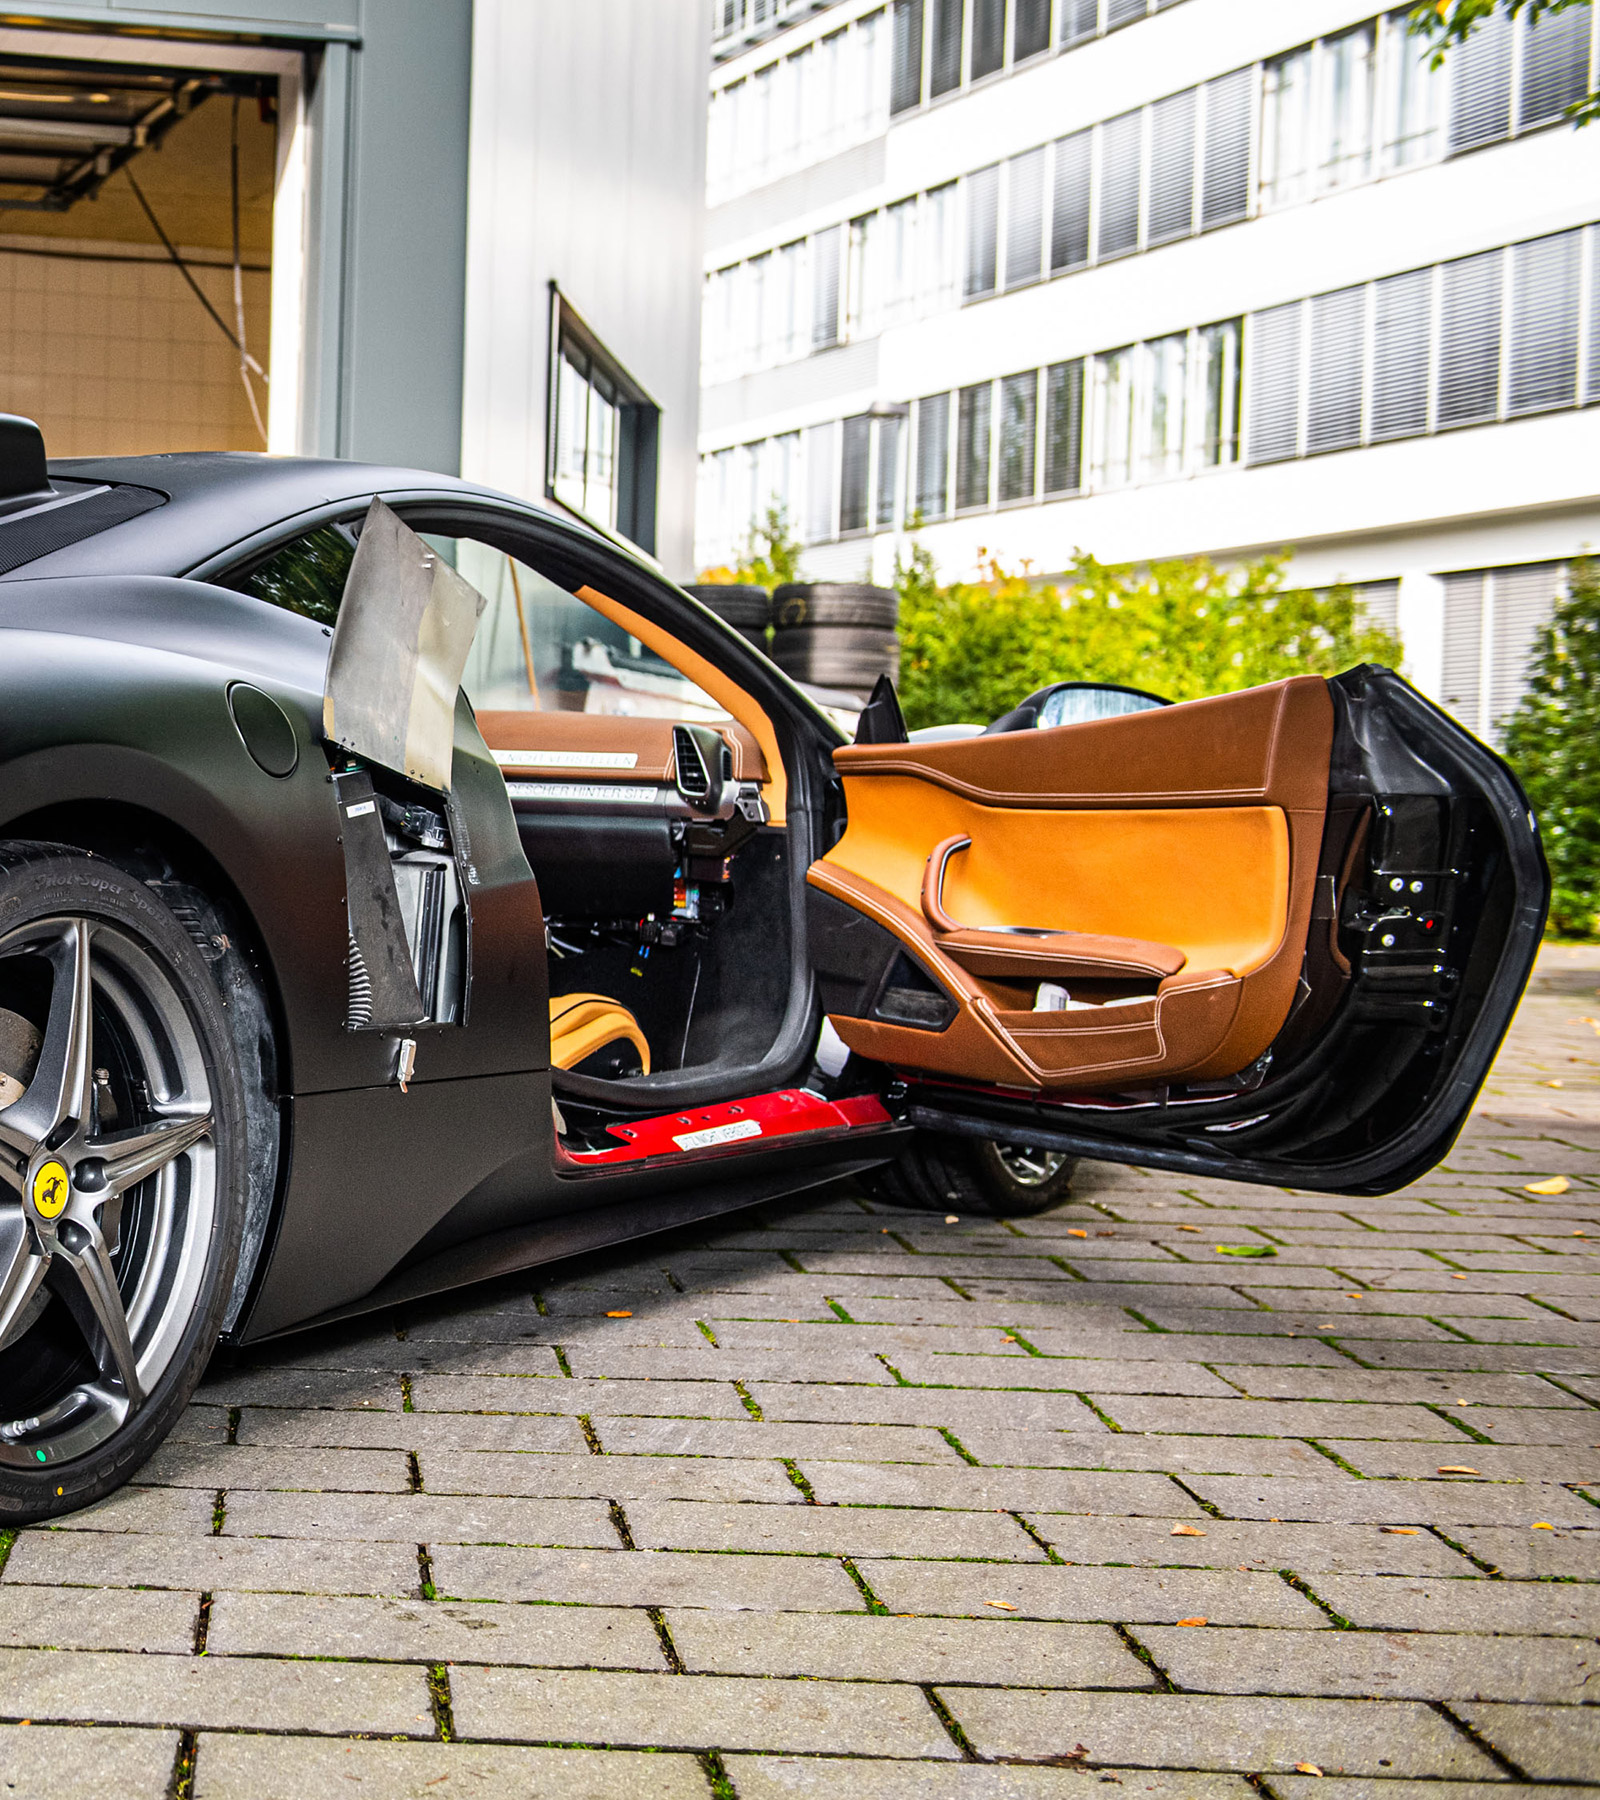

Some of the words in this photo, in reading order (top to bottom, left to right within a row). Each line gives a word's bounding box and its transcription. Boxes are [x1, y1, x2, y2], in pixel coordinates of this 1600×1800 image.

[573, 786, 621, 799] HINTER
[624, 788, 655, 800] SITZ
[78, 873, 125, 896] Super
